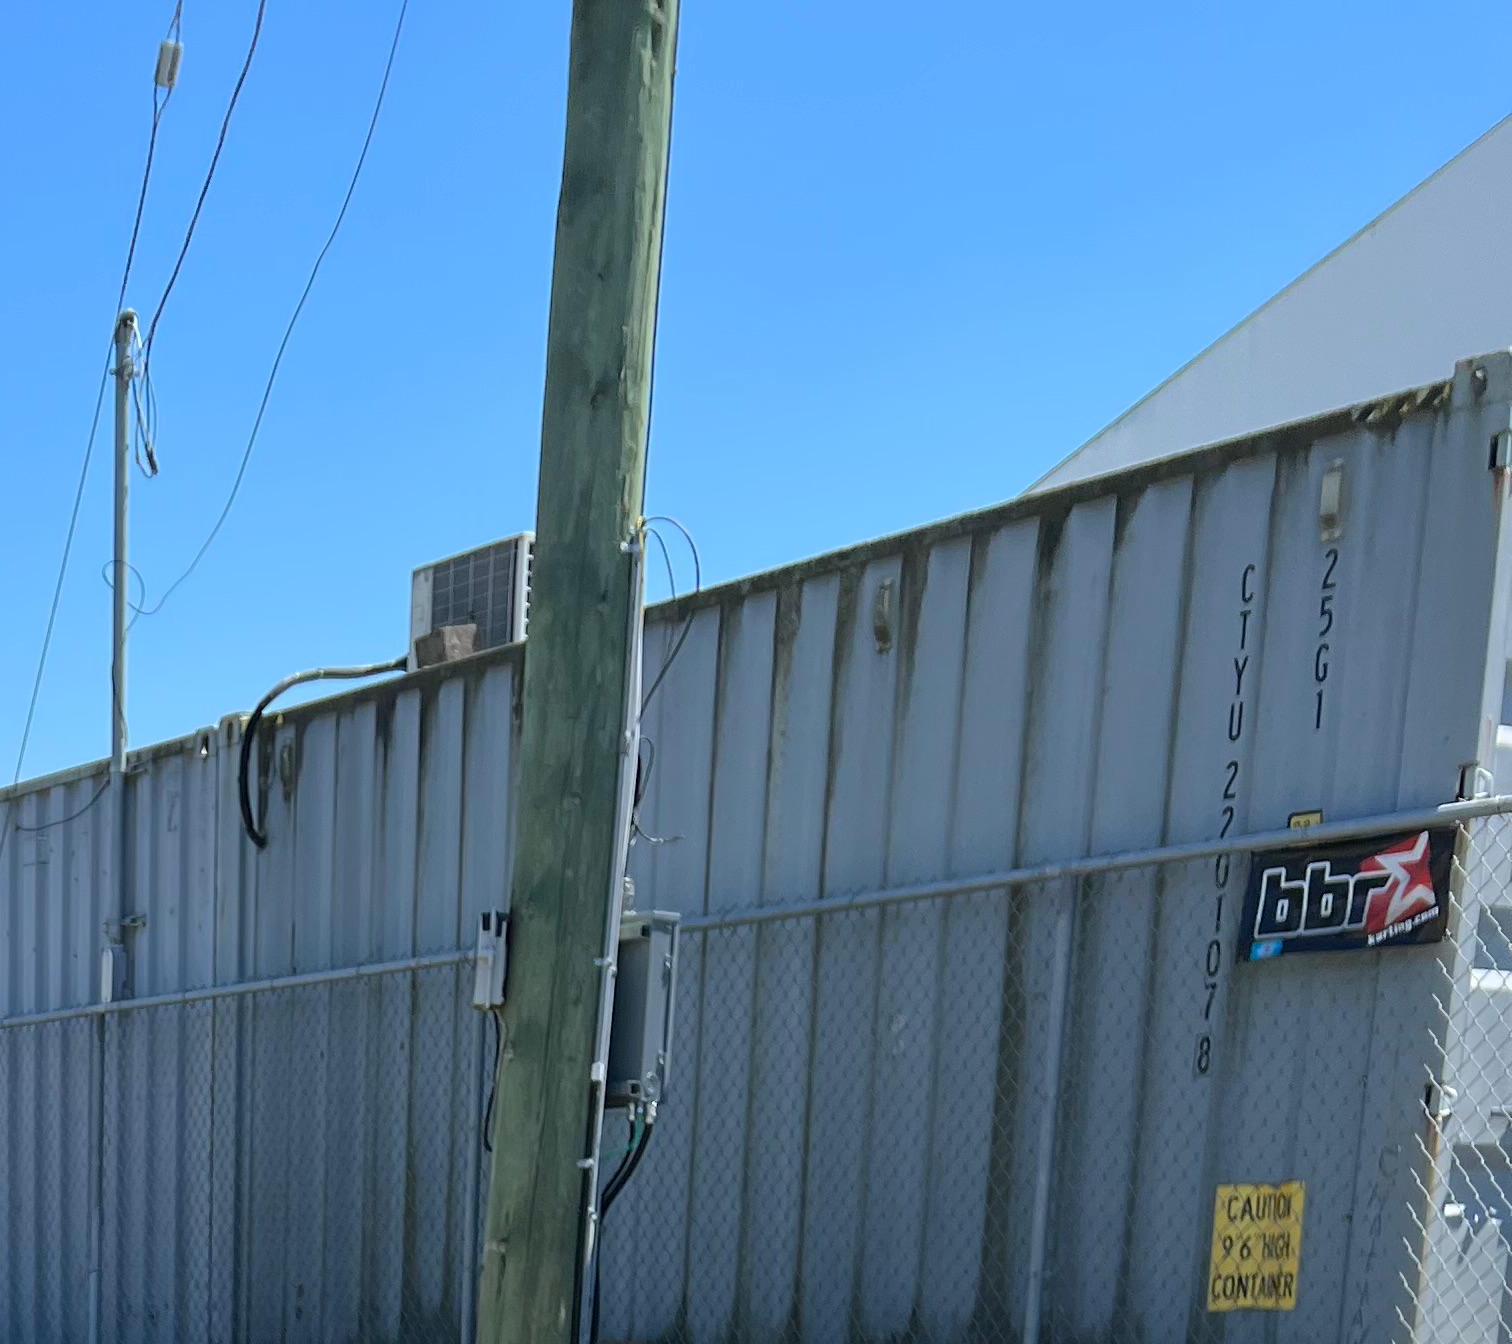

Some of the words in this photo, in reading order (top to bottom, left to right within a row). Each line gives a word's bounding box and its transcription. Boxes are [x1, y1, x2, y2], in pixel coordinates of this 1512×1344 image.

[1228, 563, 1256, 741] CTYU
[1315, 548, 1338, 729] 25G1
[1254, 861, 1394, 940] bbr
